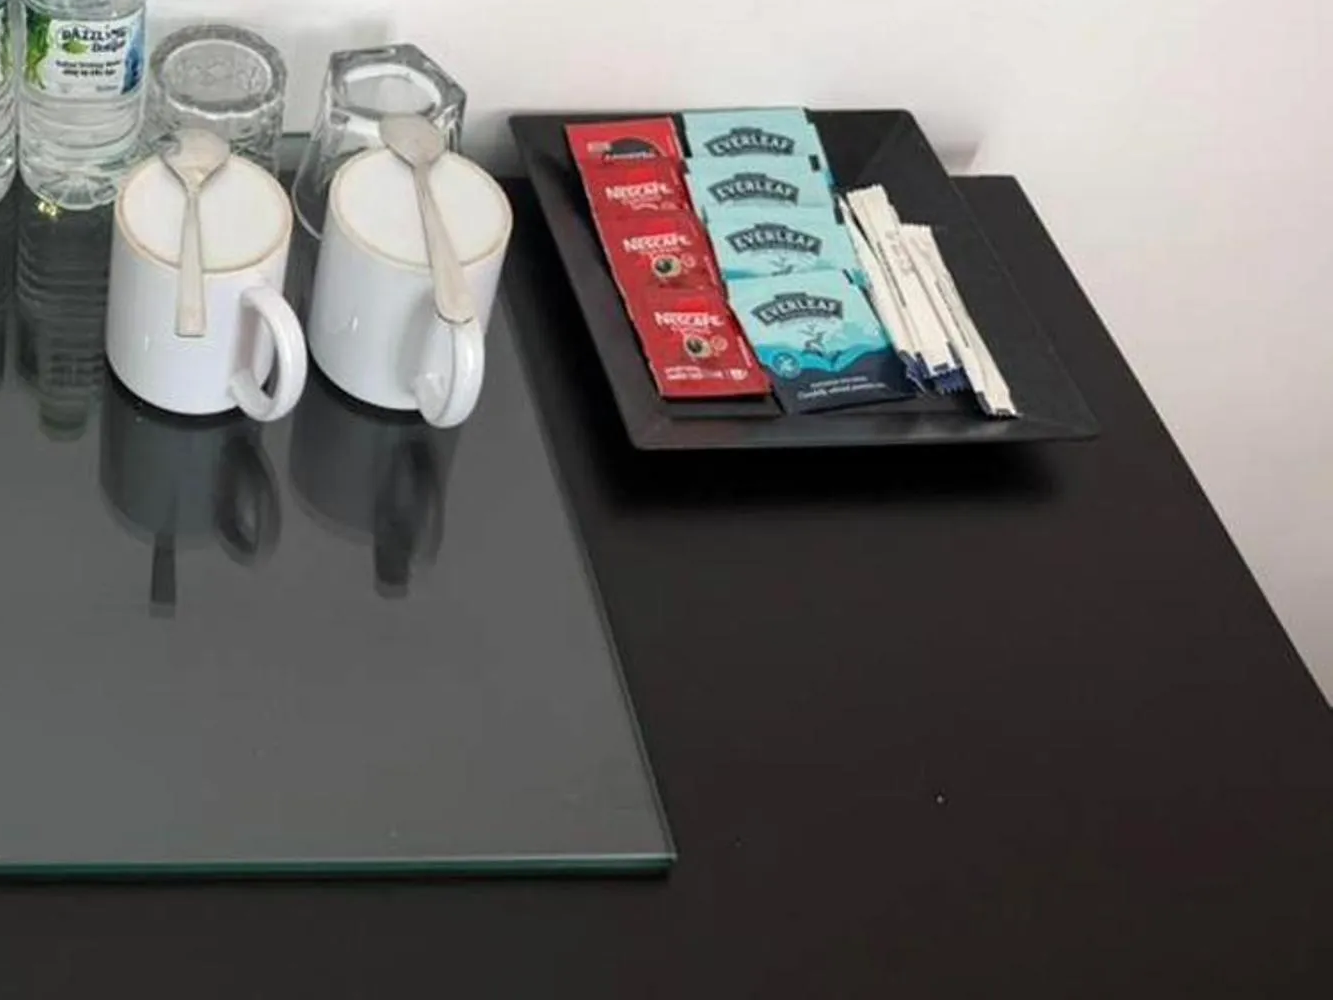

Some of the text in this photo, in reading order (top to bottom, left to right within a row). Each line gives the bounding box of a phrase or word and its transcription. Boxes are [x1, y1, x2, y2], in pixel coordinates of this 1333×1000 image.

[712, 133, 788, 153] EVERLEAF
[716, 180, 794, 199] EVERLEAF
[732, 229, 816, 250] EVERLEAF
[759, 298, 838, 322] EVERLEAF
